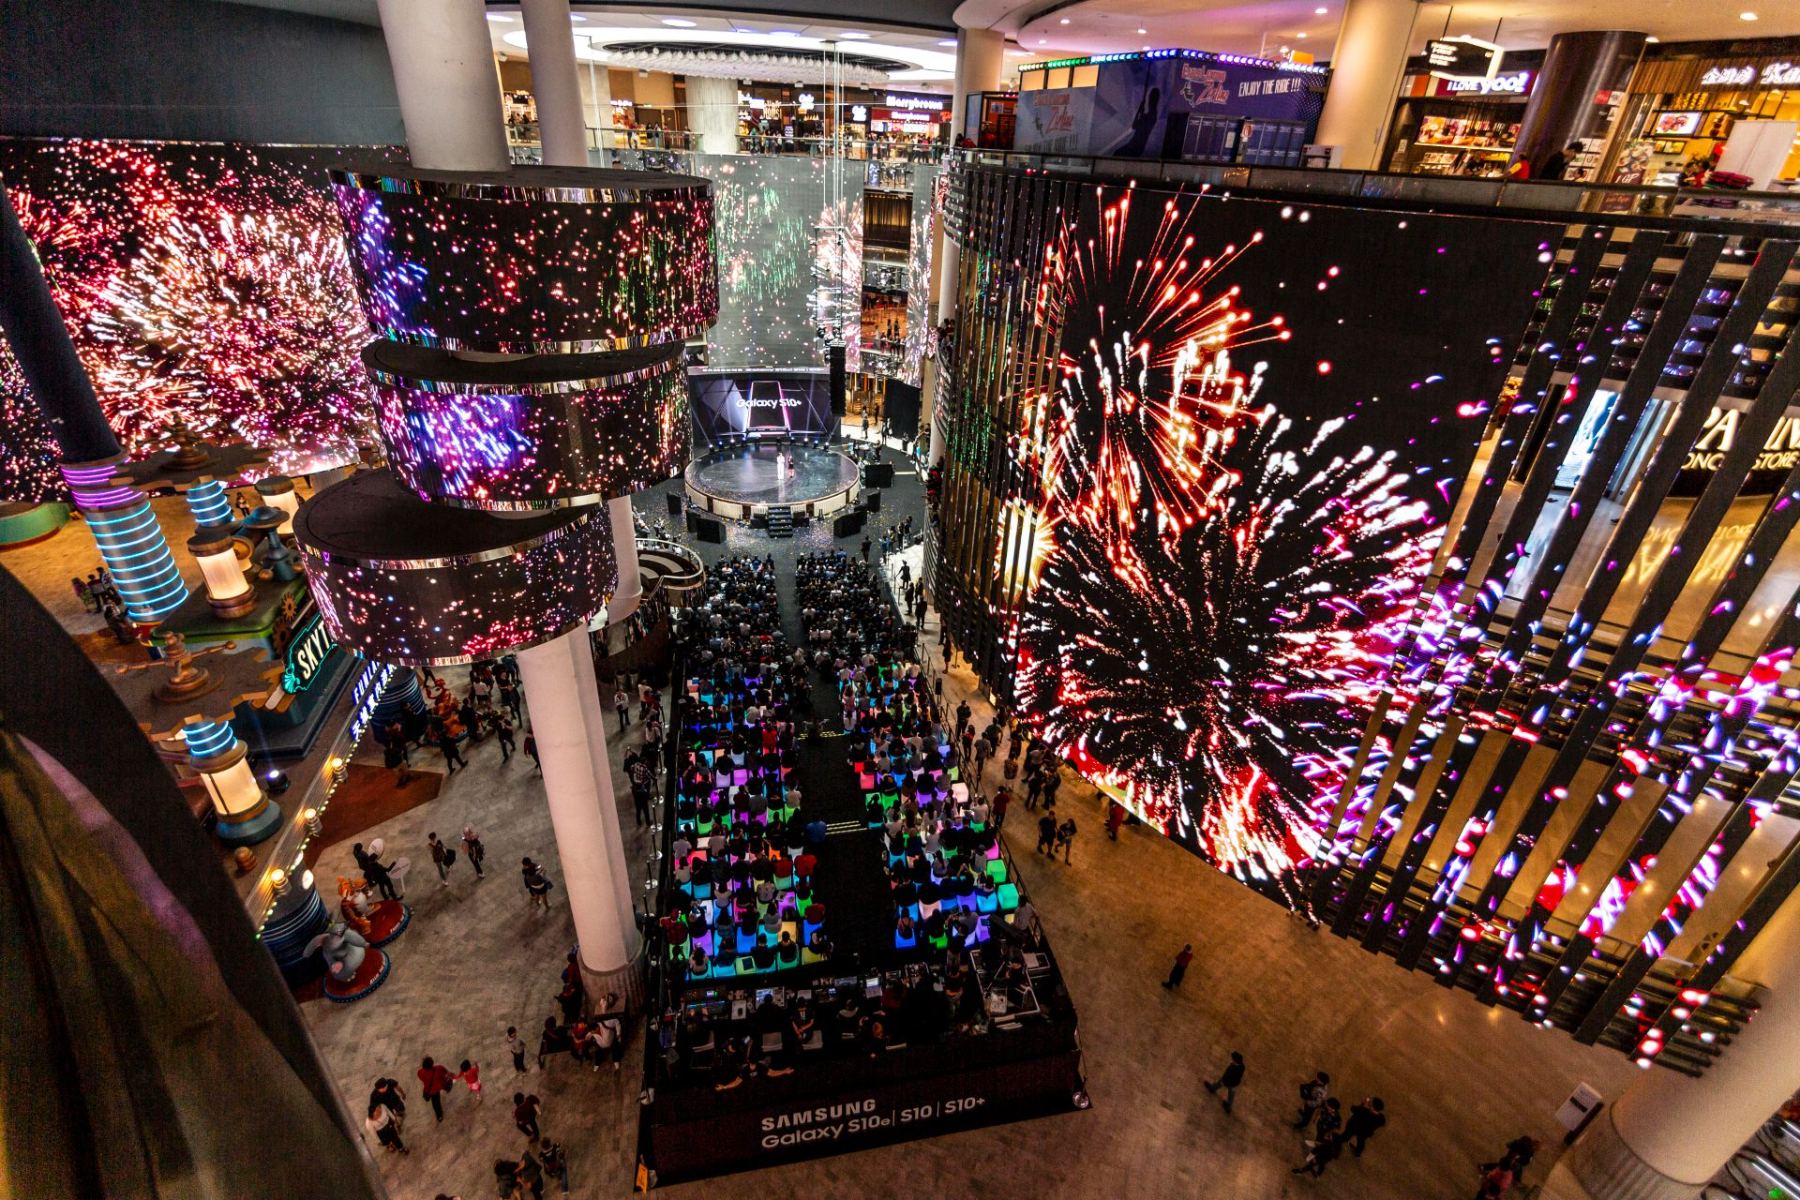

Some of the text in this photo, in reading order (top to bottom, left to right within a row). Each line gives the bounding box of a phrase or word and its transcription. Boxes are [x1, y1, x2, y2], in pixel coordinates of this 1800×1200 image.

[1238, 81, 1261, 97] ENJOY
[1262, 79, 1275, 95] THE
[1275, 78, 1291, 93] RIDE
[886, 95, 943, 110] Marrybrown
[736, 398, 778, 409] Galaxy
[761, 1098, 876, 1131] SAMSUNG
[761, 1124, 845, 1149] Galaxy
[900, 1105, 932, 1122] S10
[944, 1097, 985, 1115] S10+
